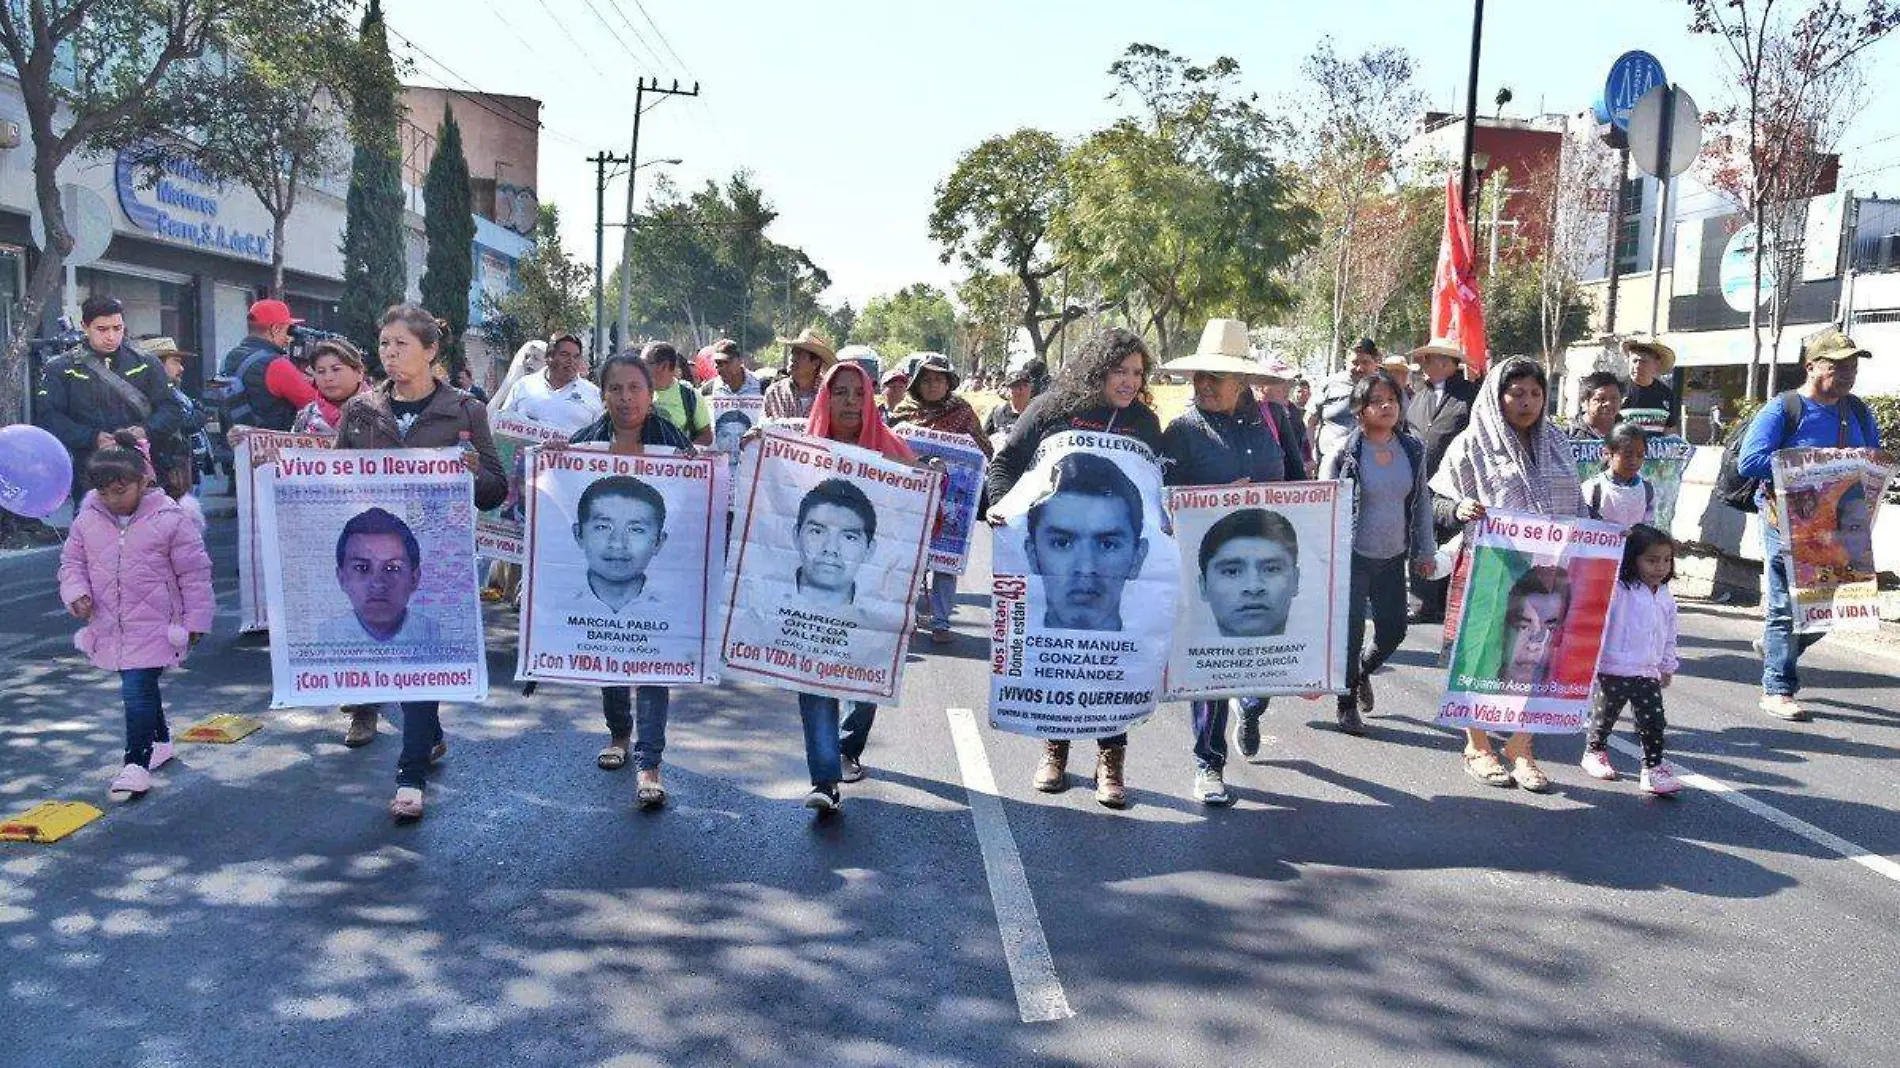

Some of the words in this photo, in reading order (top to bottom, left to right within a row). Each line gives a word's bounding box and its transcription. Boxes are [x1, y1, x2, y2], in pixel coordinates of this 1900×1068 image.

[298, 437, 313, 448] se
[318, 437, 331, 449] lo
[1068, 435, 1095, 447] LOS
[275, 456, 327, 479] ¡Vivo
[332, 460, 354, 475] se
[359, 456, 376, 475] lo
[382, 456, 466, 475] llevaron!
[539, 452, 584, 471] ¡Vivo
[588, 458, 608, 472] se
[612, 456, 630, 474] lo
[634, 460, 708, 479] llevaron!
[764, 440, 810, 465] ¡Vivo
[812, 454, 834, 470] se
[837, 457, 853, 476] lo
[858, 462, 929, 493] llevaron!
[1223, 492, 1241, 507] se
[1245, 489, 1260, 506] lo
[1264, 486, 1332, 505] llevaron!
[1478, 516, 1519, 538] ¡Vivo
[1524, 525, 1543, 540] se
[1547, 524, 1563, 542] lo
[497, 539, 516, 553] VIDA
[778, 607, 858, 629] MAURICIO
[992, 600, 1007, 643] faltan
[1805, 607, 1833, 622] ¡Con
[1837, 605, 1869, 618] VIDA
[567, 616, 624, 630] MARCIAL
[626, 619, 669, 631] PABLO
[784, 618, 848, 637] ORTEGA
[586, 630, 648, 643] BARANDA
[775, 638, 804, 651] EDAD
[781, 627, 849, 647] VALERIO
[1025, 635, 1074, 649] CÉSAR
[1077, 638, 1139, 653] MANUEL
[628, 645, 660, 655] AÑOS
[1038, 651, 1119, 666] GONZÁLEZ
[1187, 646, 1235, 657] MARTÍN
[1237, 643, 1307, 656] GETSEMANY
[533, 652, 563, 670] ¡Con
[568, 654, 602, 671] VIDA
[605, 656, 619, 673] lo
[622, 660, 696, 677] queremos!
[730, 641, 761, 661] ¡Con
[765, 646, 798, 670] VIDA
[801, 655, 813, 673] lo
[816, 661, 886, 685] queremos!
[992, 646, 1005, 675] Nos
[296, 671, 329, 692] ¡Con
[333, 671, 371, 688] VIDA
[375, 670, 390, 687] lo
[393, 668, 472, 690] queremos!
[1034, 667, 1125, 681] HERNÁNDEZ
[998, 685, 1044, 704] ¡VIVOS
[1046, 690, 1075, 705] LOS
[997, 708, 1021, 718] CONTRA
[1030, 712, 1073, 722] TERRORISMO
[1440, 701, 1470, 719] ¡Con
[1473, 703, 1501, 722] Vida
[1504, 706, 1516, 723] lo
[1518, 708, 1583, 728] queremos!
